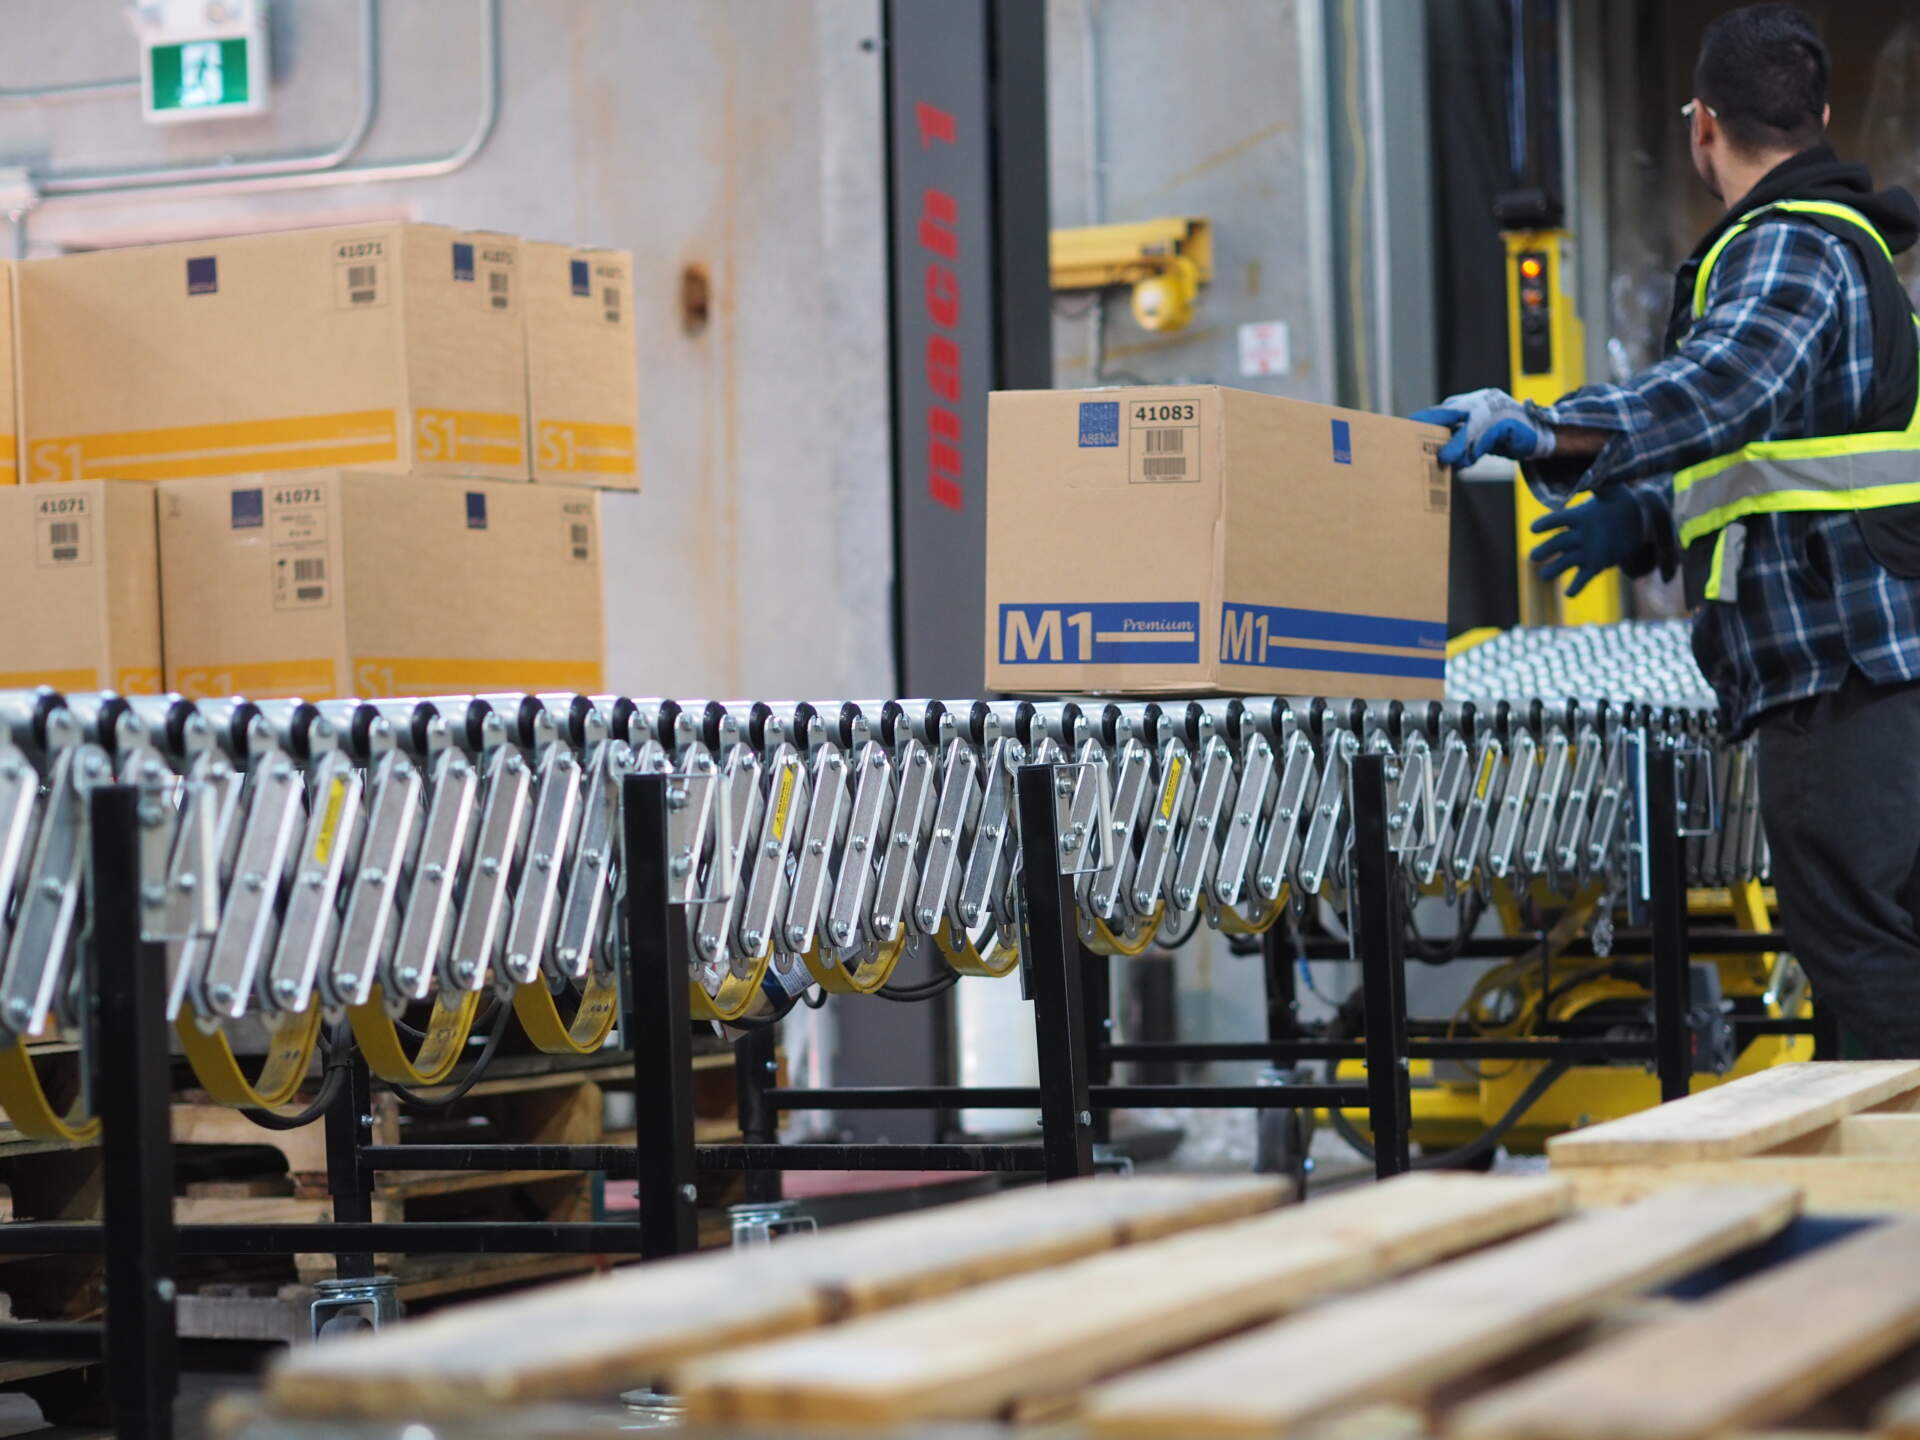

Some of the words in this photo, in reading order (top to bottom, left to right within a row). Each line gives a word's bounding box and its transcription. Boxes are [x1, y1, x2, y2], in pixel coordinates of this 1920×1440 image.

[1136, 405, 1194, 421] 41083
[419, 415, 457, 458] S1
[541, 427, 576, 468] S1
[1080, 431, 1117, 445] ABENA
[35, 444, 82, 481] S1
[40, 498, 85, 513] 41071
[274, 488, 321, 504] 41071
[1003, 610, 1093, 661] M1
[1122, 618, 1194, 632] Premium
[1220, 610, 1269, 663] M1
